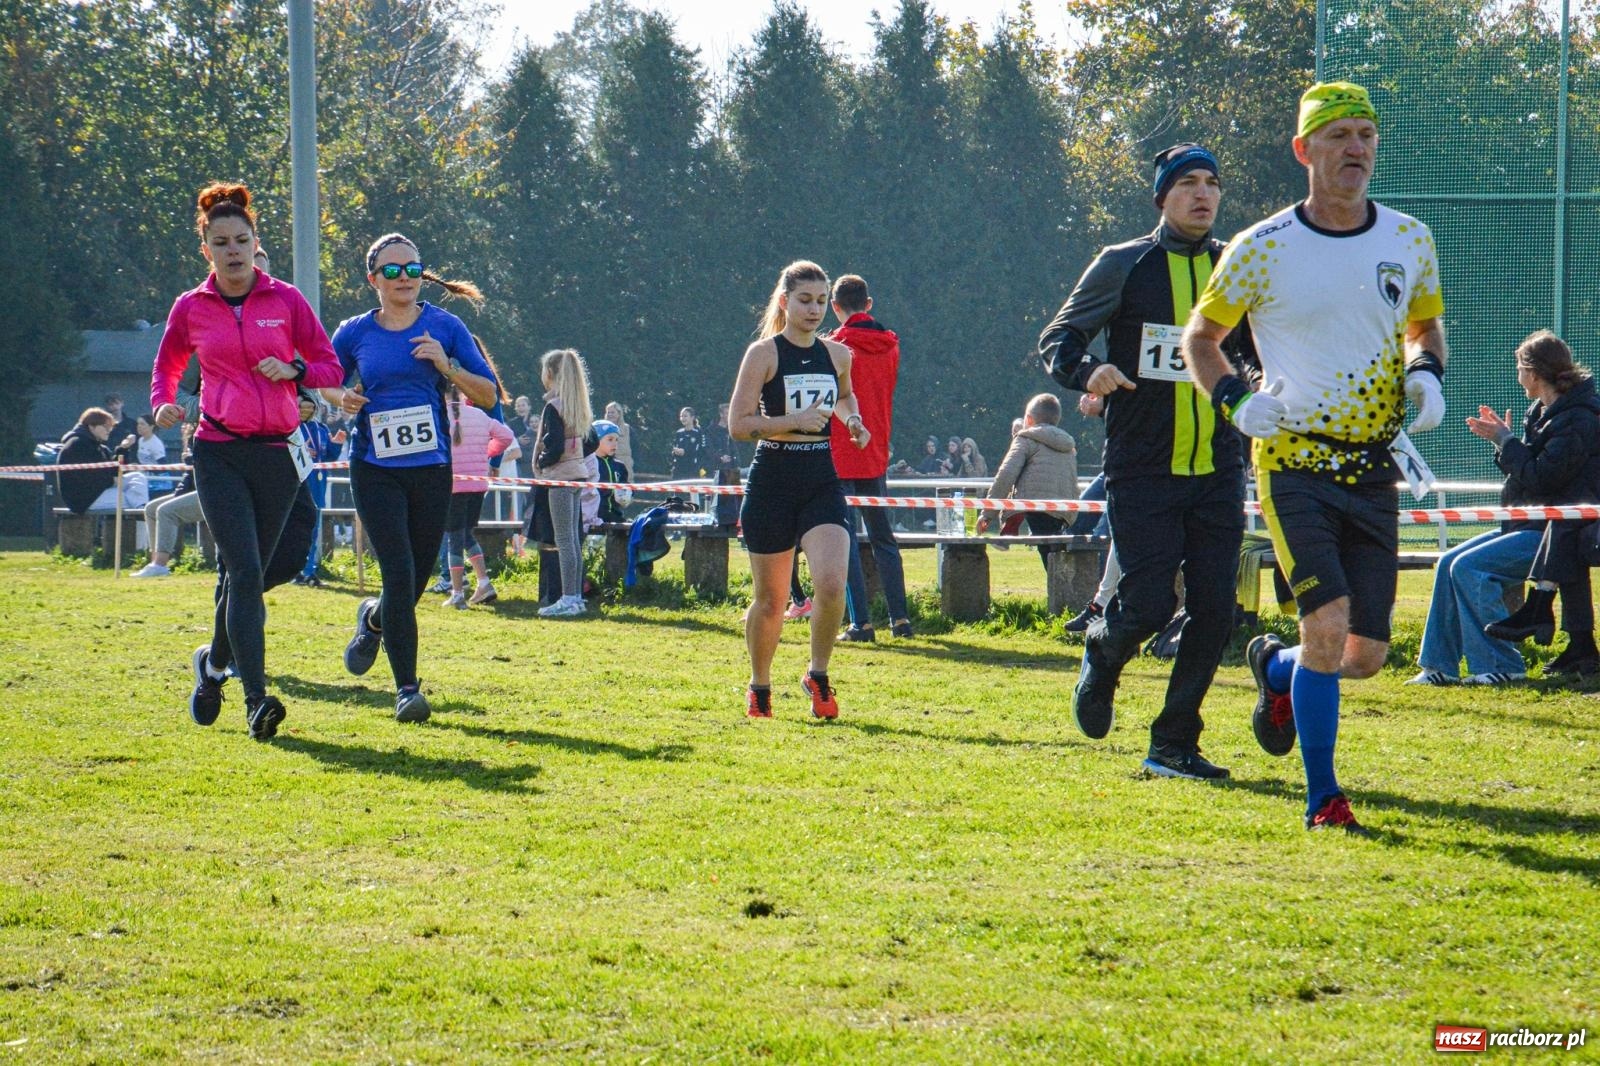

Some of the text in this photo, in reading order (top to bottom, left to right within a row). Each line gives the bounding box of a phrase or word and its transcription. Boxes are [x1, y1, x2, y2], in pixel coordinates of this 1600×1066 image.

[1256, 220, 1293, 239] COLO
[1146, 344, 1187, 371] 15
[790, 389, 834, 409] 174
[377, 421, 433, 448] 185
[783, 443, 811, 451] NIKE
[812, 441, 829, 451] PRO
